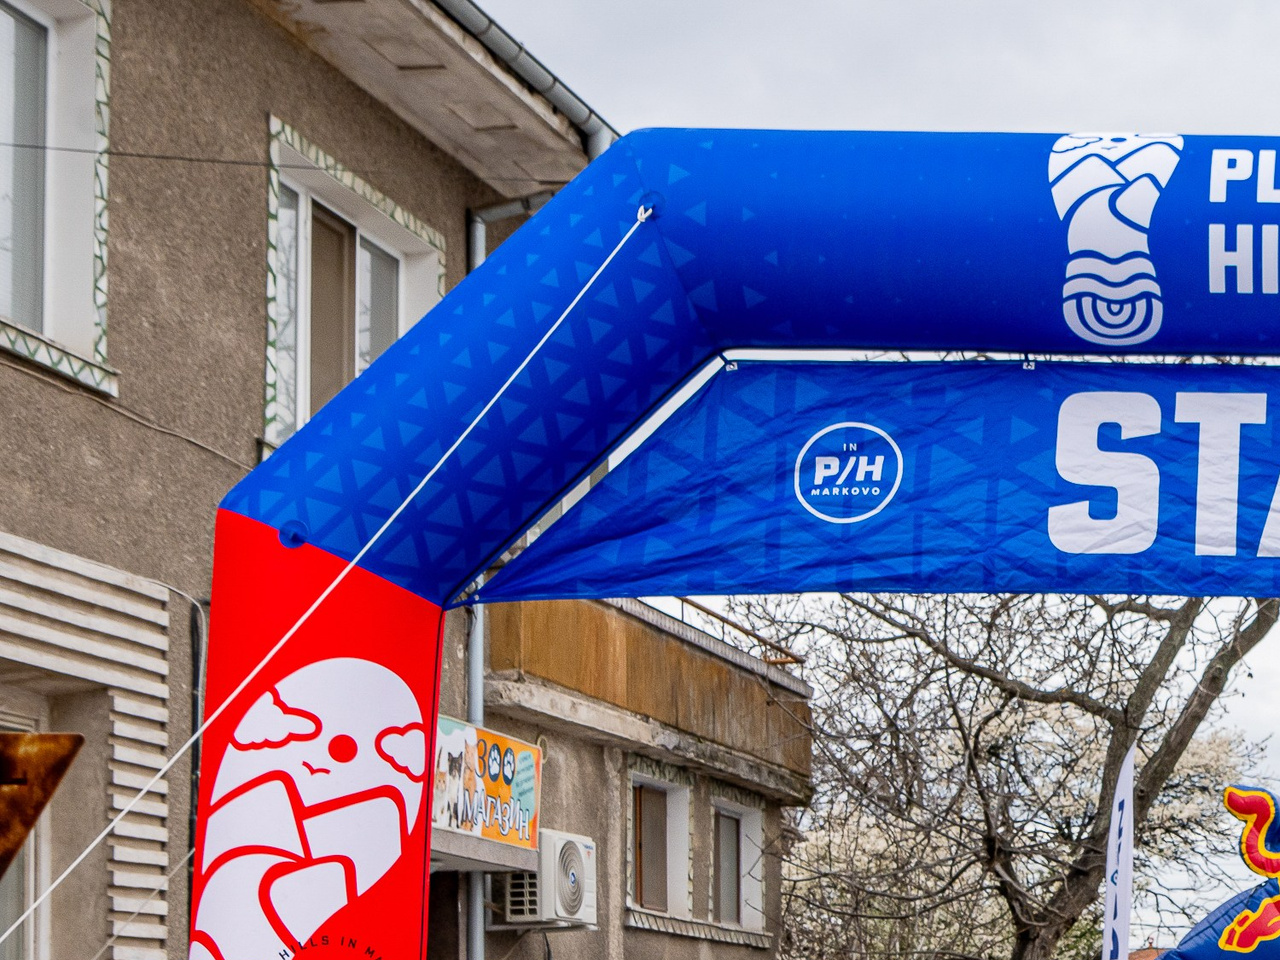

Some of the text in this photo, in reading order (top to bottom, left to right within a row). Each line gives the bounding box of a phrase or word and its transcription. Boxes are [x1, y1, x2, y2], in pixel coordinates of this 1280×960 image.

[843, 443, 857, 452] IN
[814, 455, 884, 485] P/H
[811, 487, 881, 496] MARKOVO
[463, 789, 530, 840] МАГАЗИН
[279, 935, 329, 960] HILLS
[341, 936, 357, 949] IN
